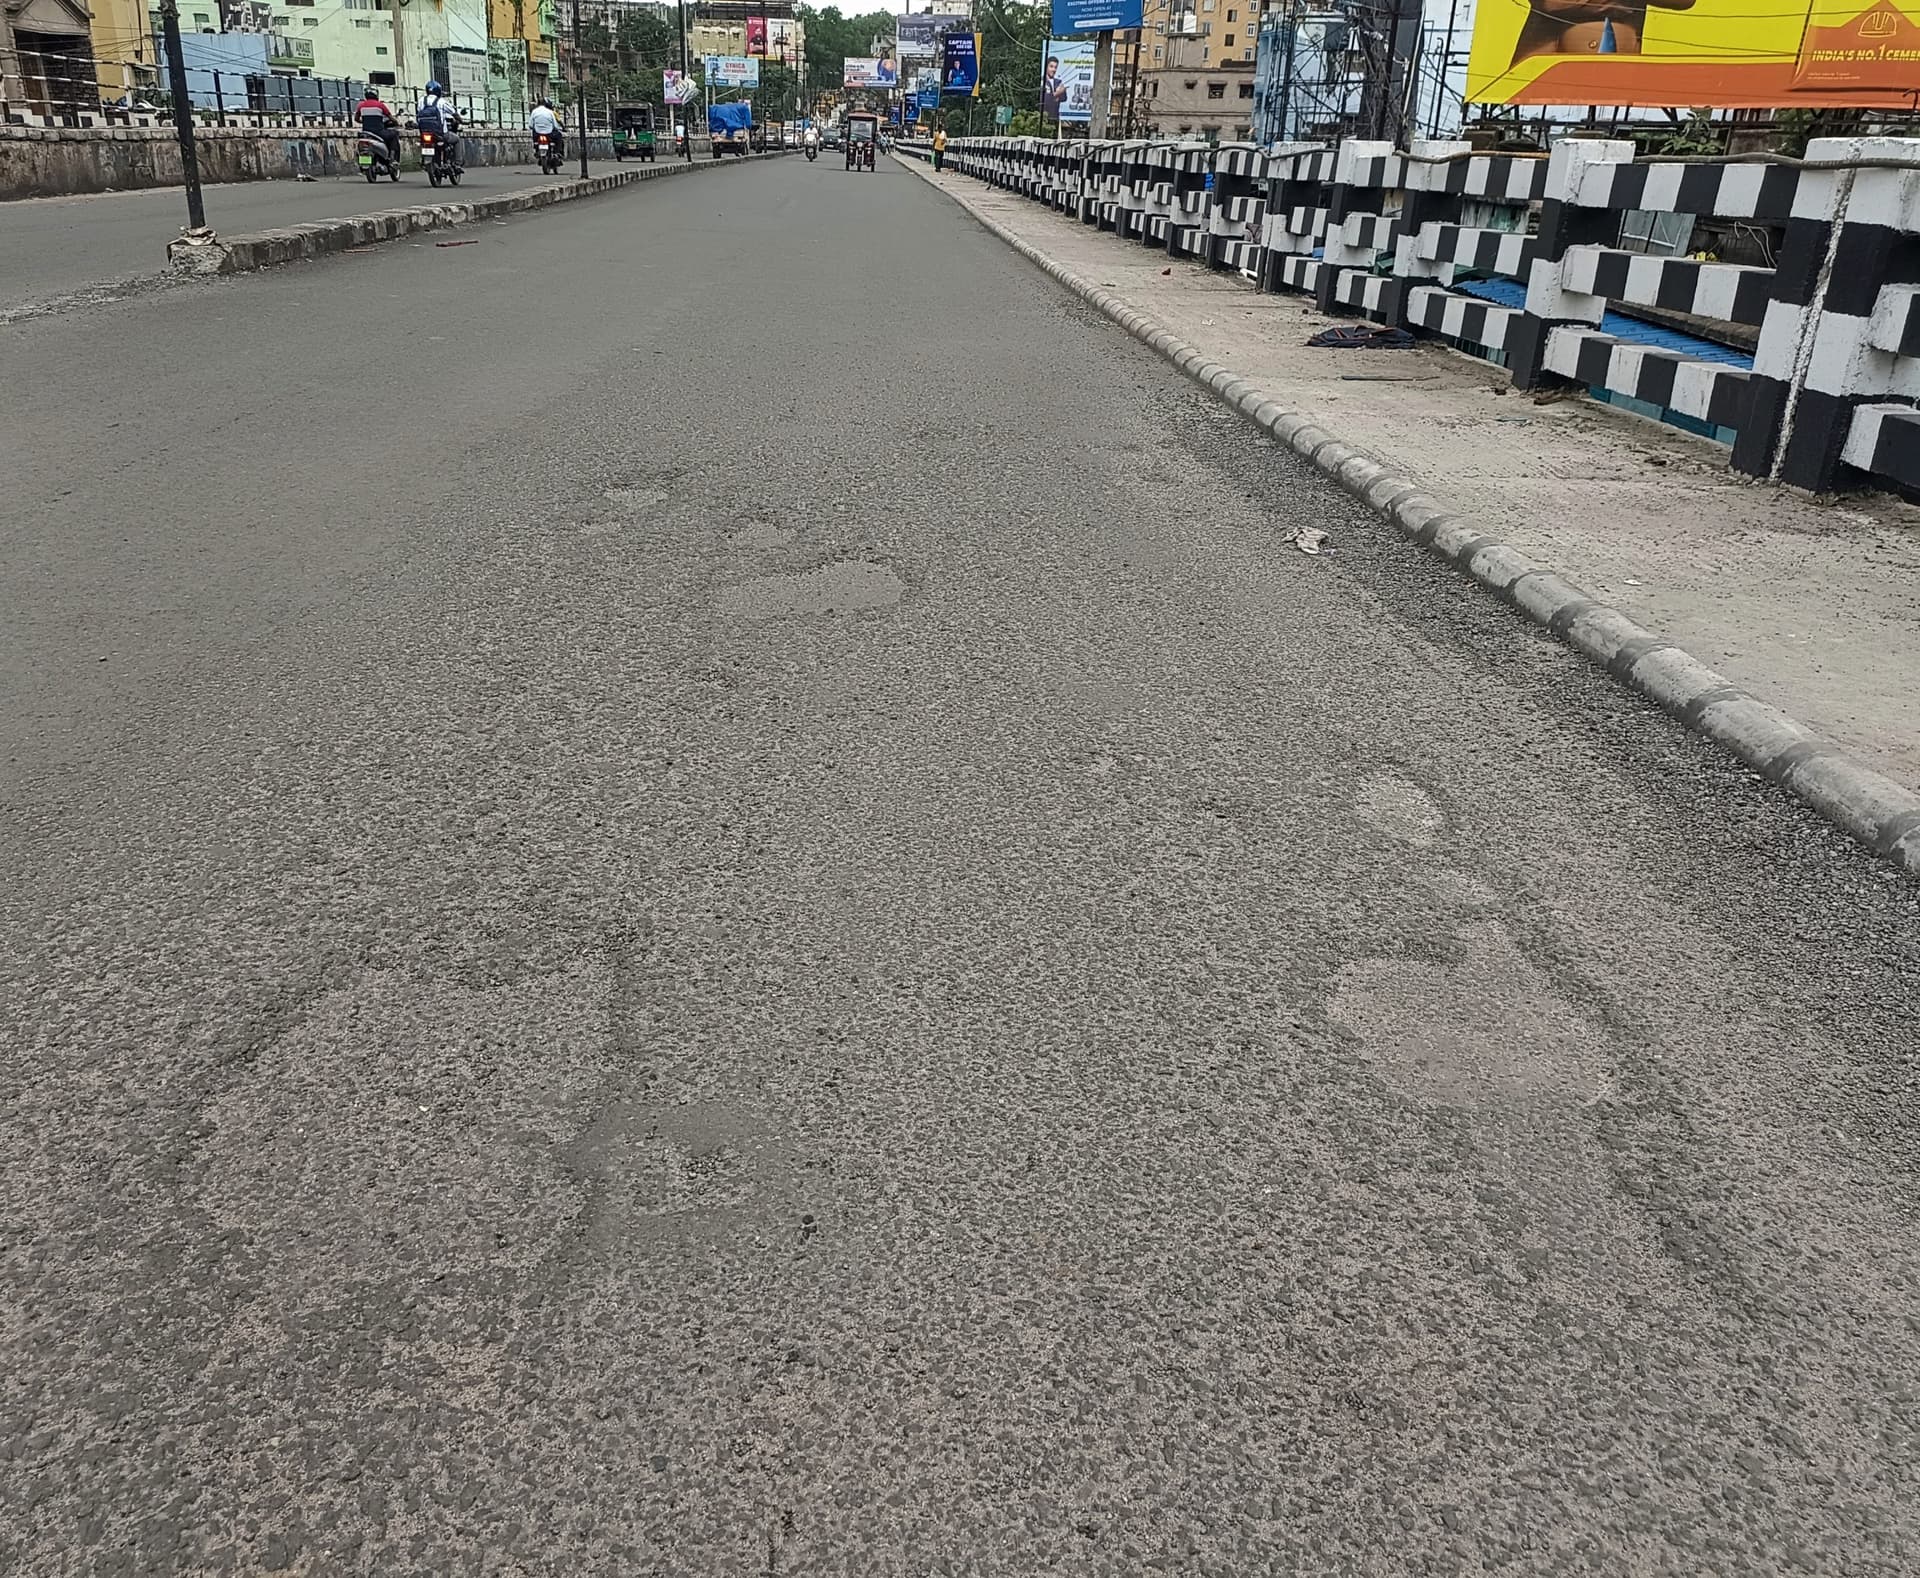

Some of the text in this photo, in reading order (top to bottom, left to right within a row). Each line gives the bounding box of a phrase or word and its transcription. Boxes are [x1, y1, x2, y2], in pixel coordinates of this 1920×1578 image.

[1812, 50, 1855, 61] INDIA'S
[1856, 49, 1877, 61] NO.
[1878, 44, 1886, 60] 1
